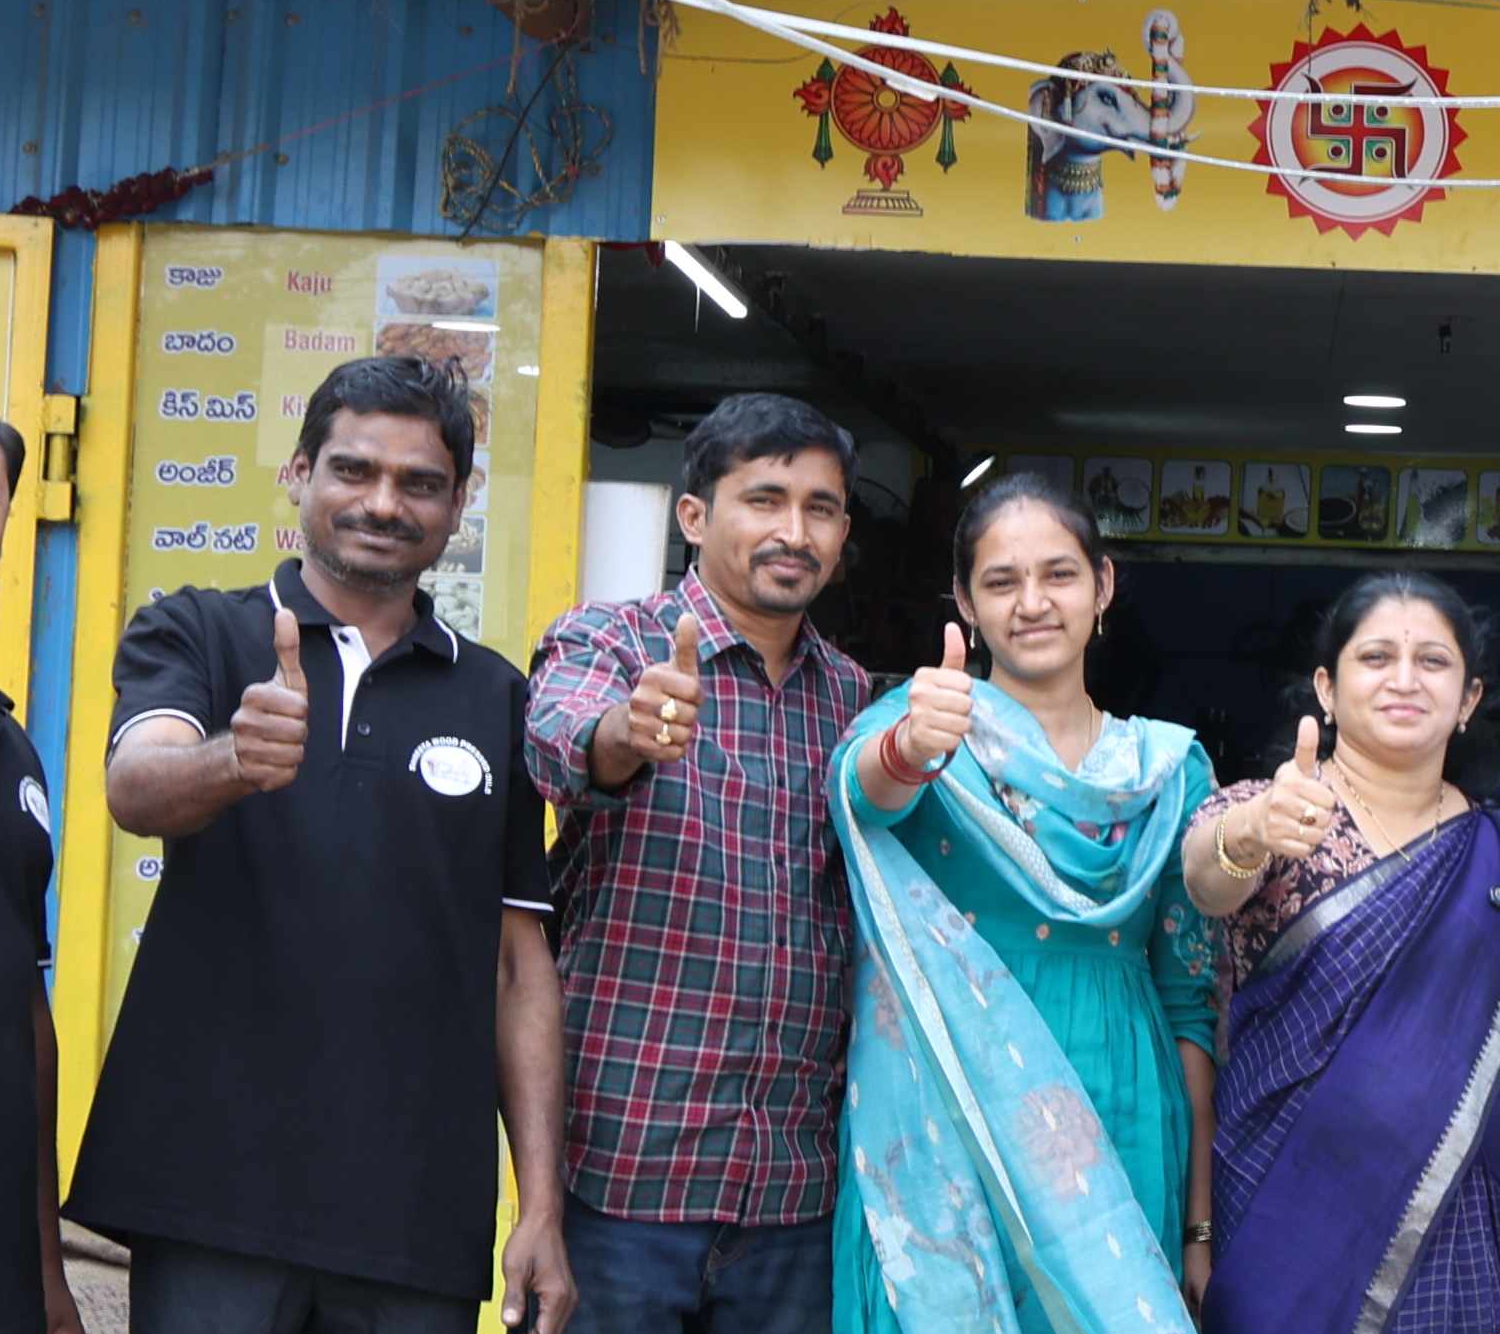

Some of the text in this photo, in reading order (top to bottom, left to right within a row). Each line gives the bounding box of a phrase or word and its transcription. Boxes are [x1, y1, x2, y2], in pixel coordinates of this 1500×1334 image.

[168, 266, 222, 286] కాజు
[287, 271, 332, 296] Kaju
[165, 332, 234, 354] బాదం
[284, 329, 355, 351] Badam
[162, 390, 198, 417] కిస్
[205, 394, 255, 419] మిస్
[158, 458, 235, 484] అంజీర్
[155, 524, 207, 549] వాల్
[213, 526, 257, 551] నట్
